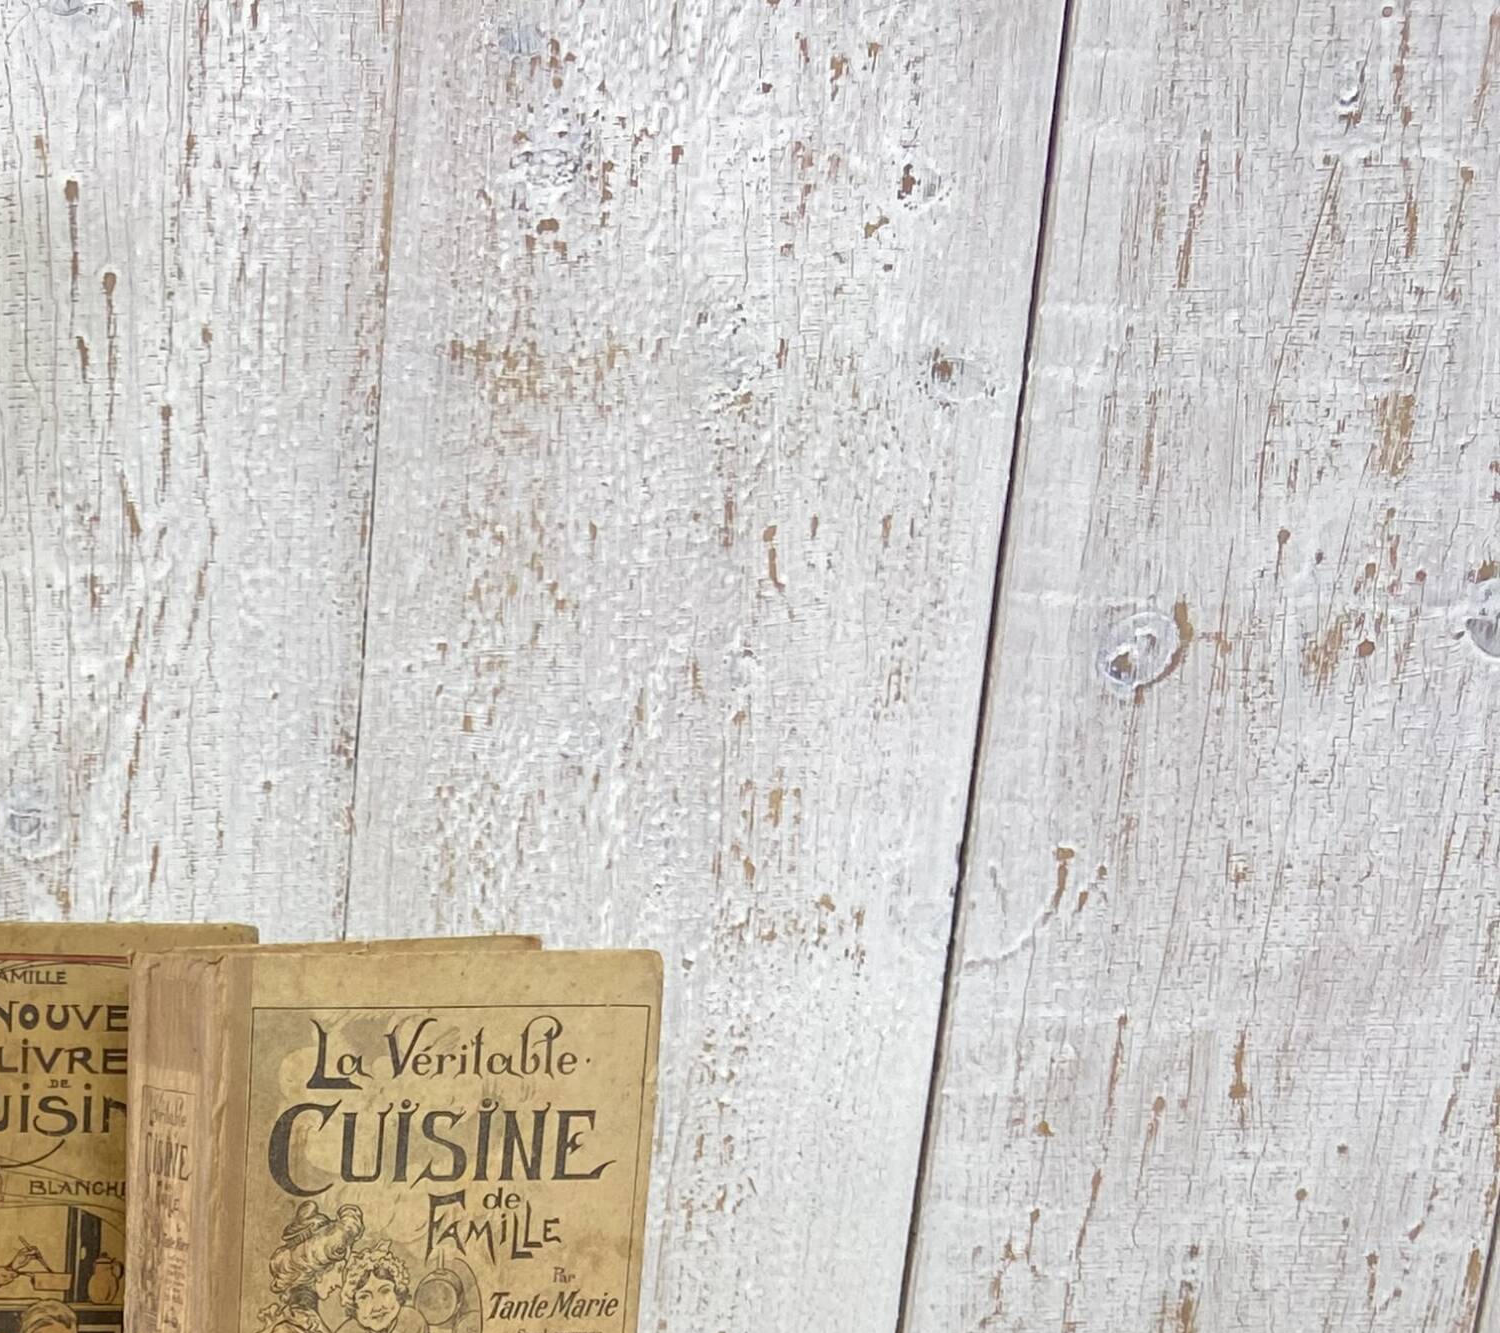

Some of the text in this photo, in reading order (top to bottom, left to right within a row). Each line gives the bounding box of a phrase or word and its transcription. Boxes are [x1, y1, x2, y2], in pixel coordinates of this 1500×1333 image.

[306, 1014, 579, 1090] La Véritable
[47, 1079, 72, 1089] DE
[267, 1098, 618, 1197] CUISINE
[482, 1187, 522, 1210] de
[424, 1189, 563, 1266] FAMILLE
[552, 1266, 577, 1284] Par
[486, 1288, 620, 1321] Tante Marie
